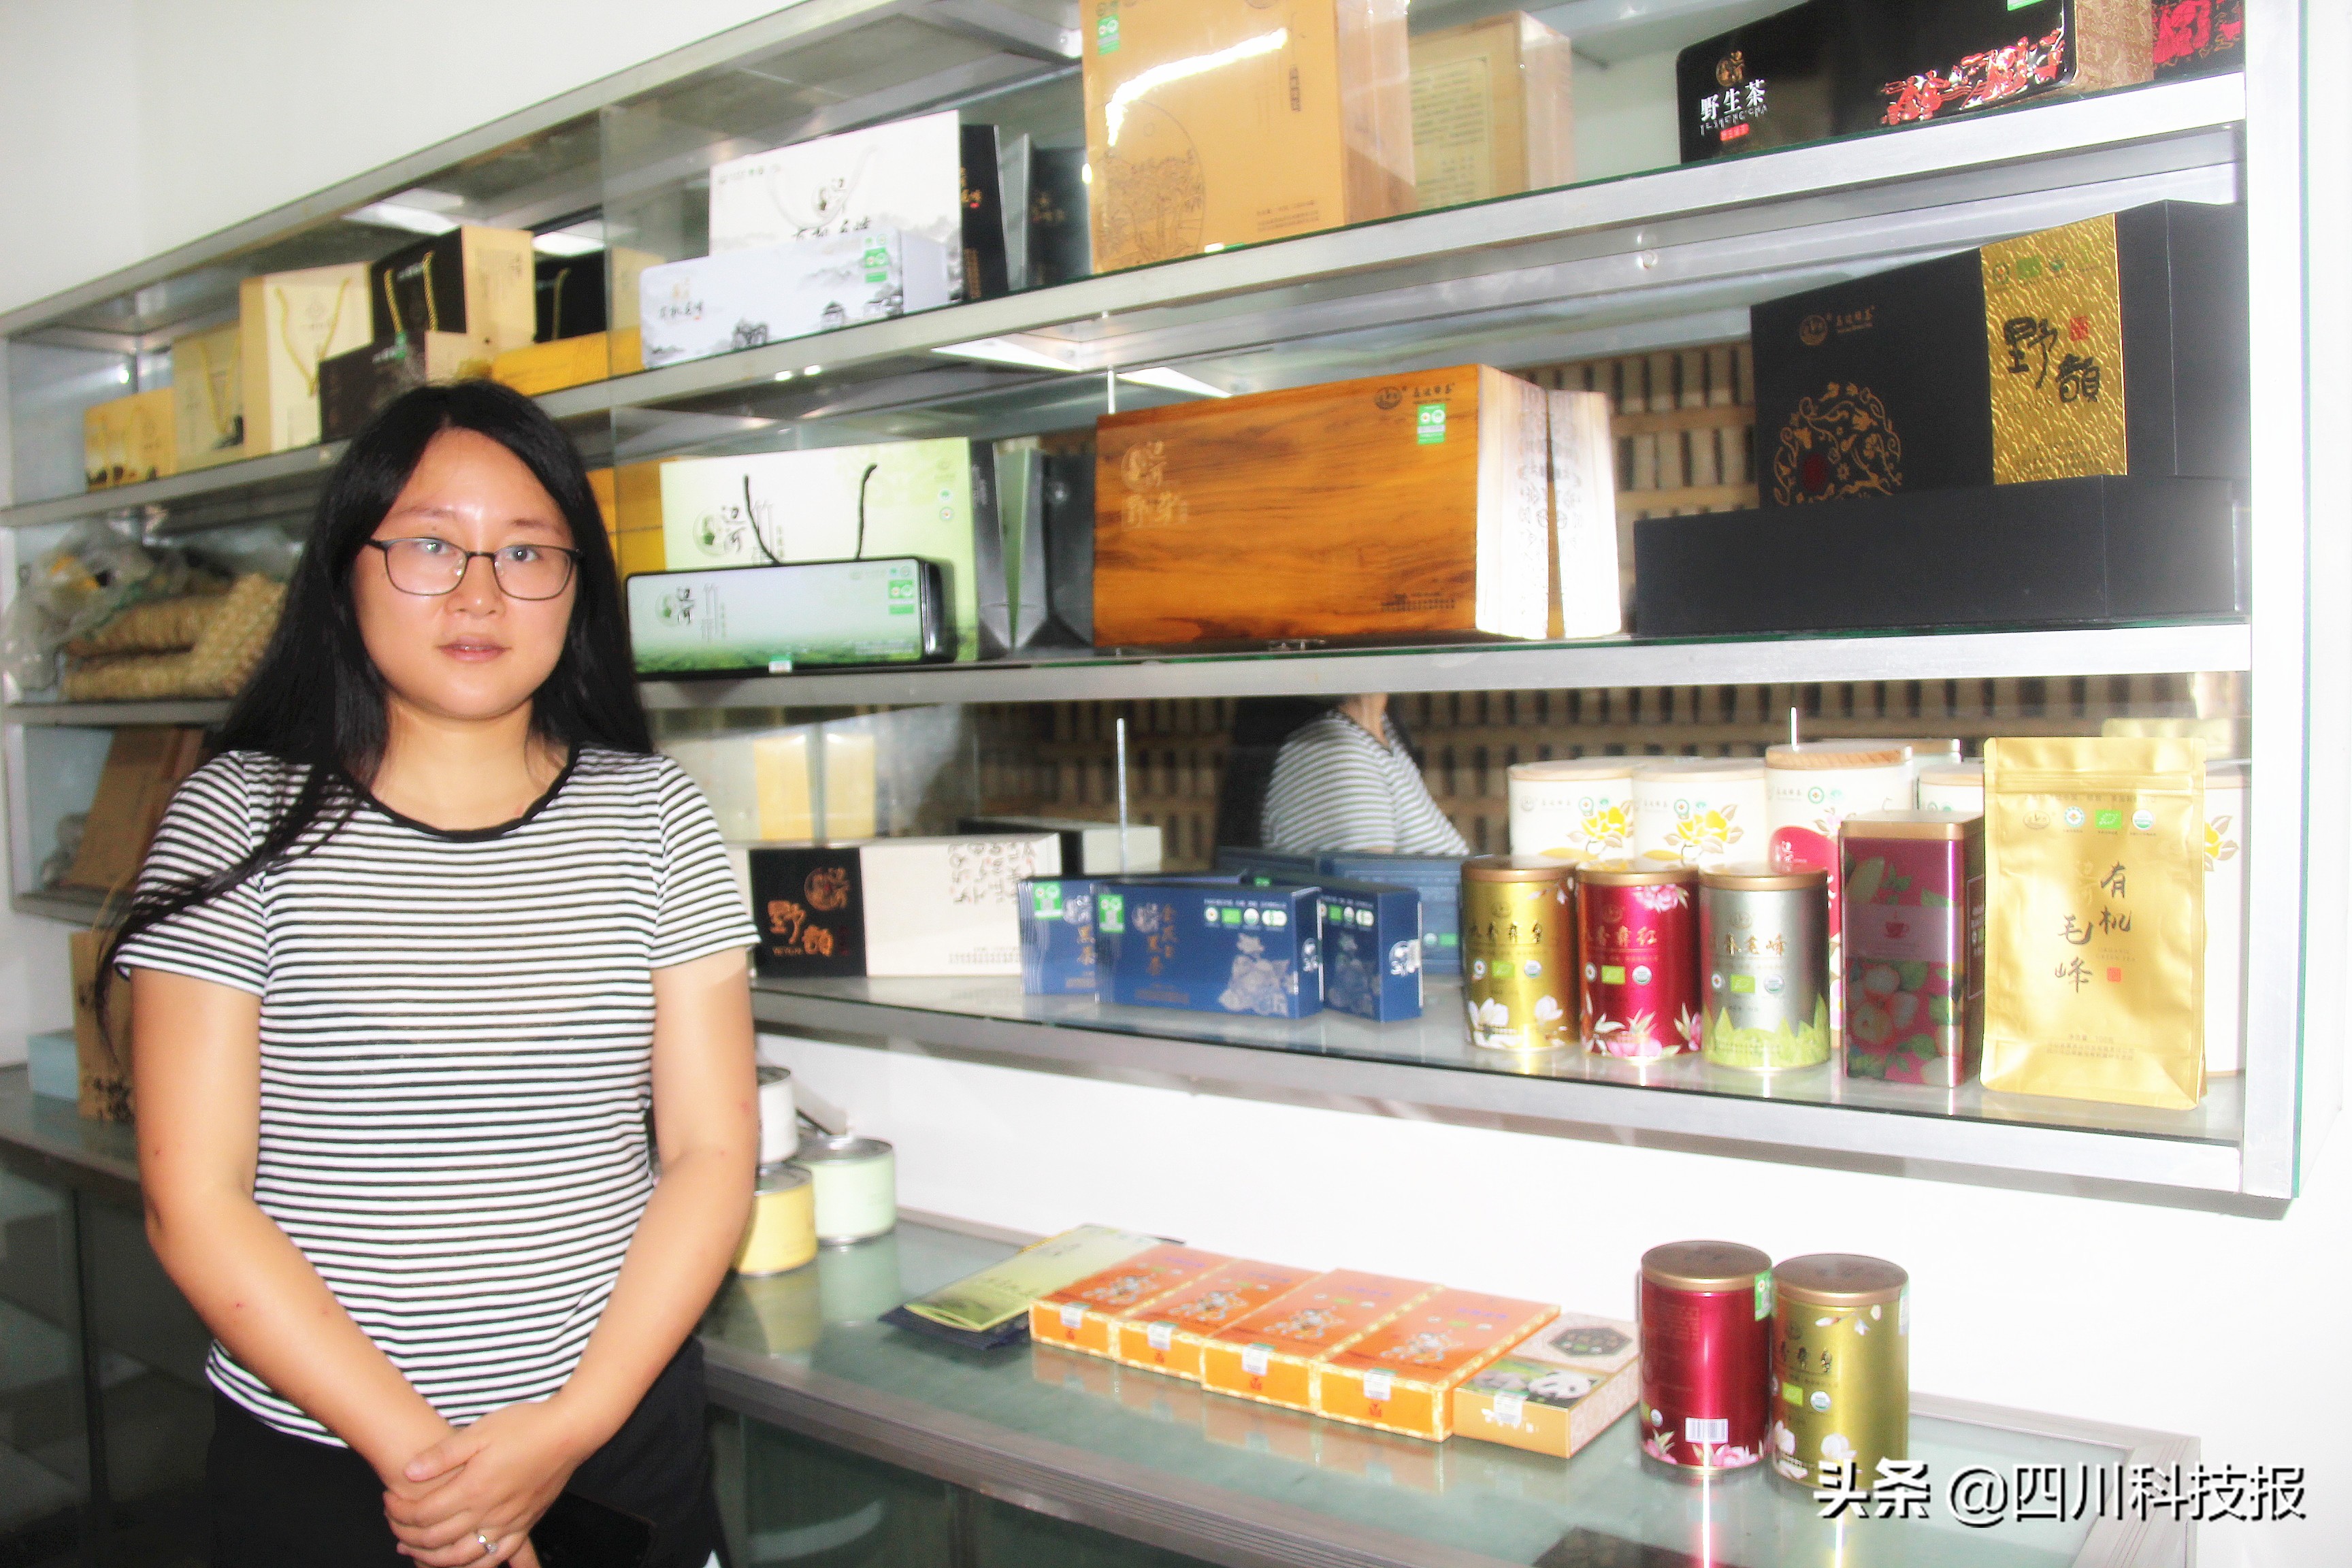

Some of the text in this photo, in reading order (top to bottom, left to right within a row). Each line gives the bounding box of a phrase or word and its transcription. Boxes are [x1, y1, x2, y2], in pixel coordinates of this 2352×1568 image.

[1701, 78, 1767, 122] 野生茶
[2098, 860, 2132, 936] 有机
[2054, 913, 2094, 994] 毛峰
